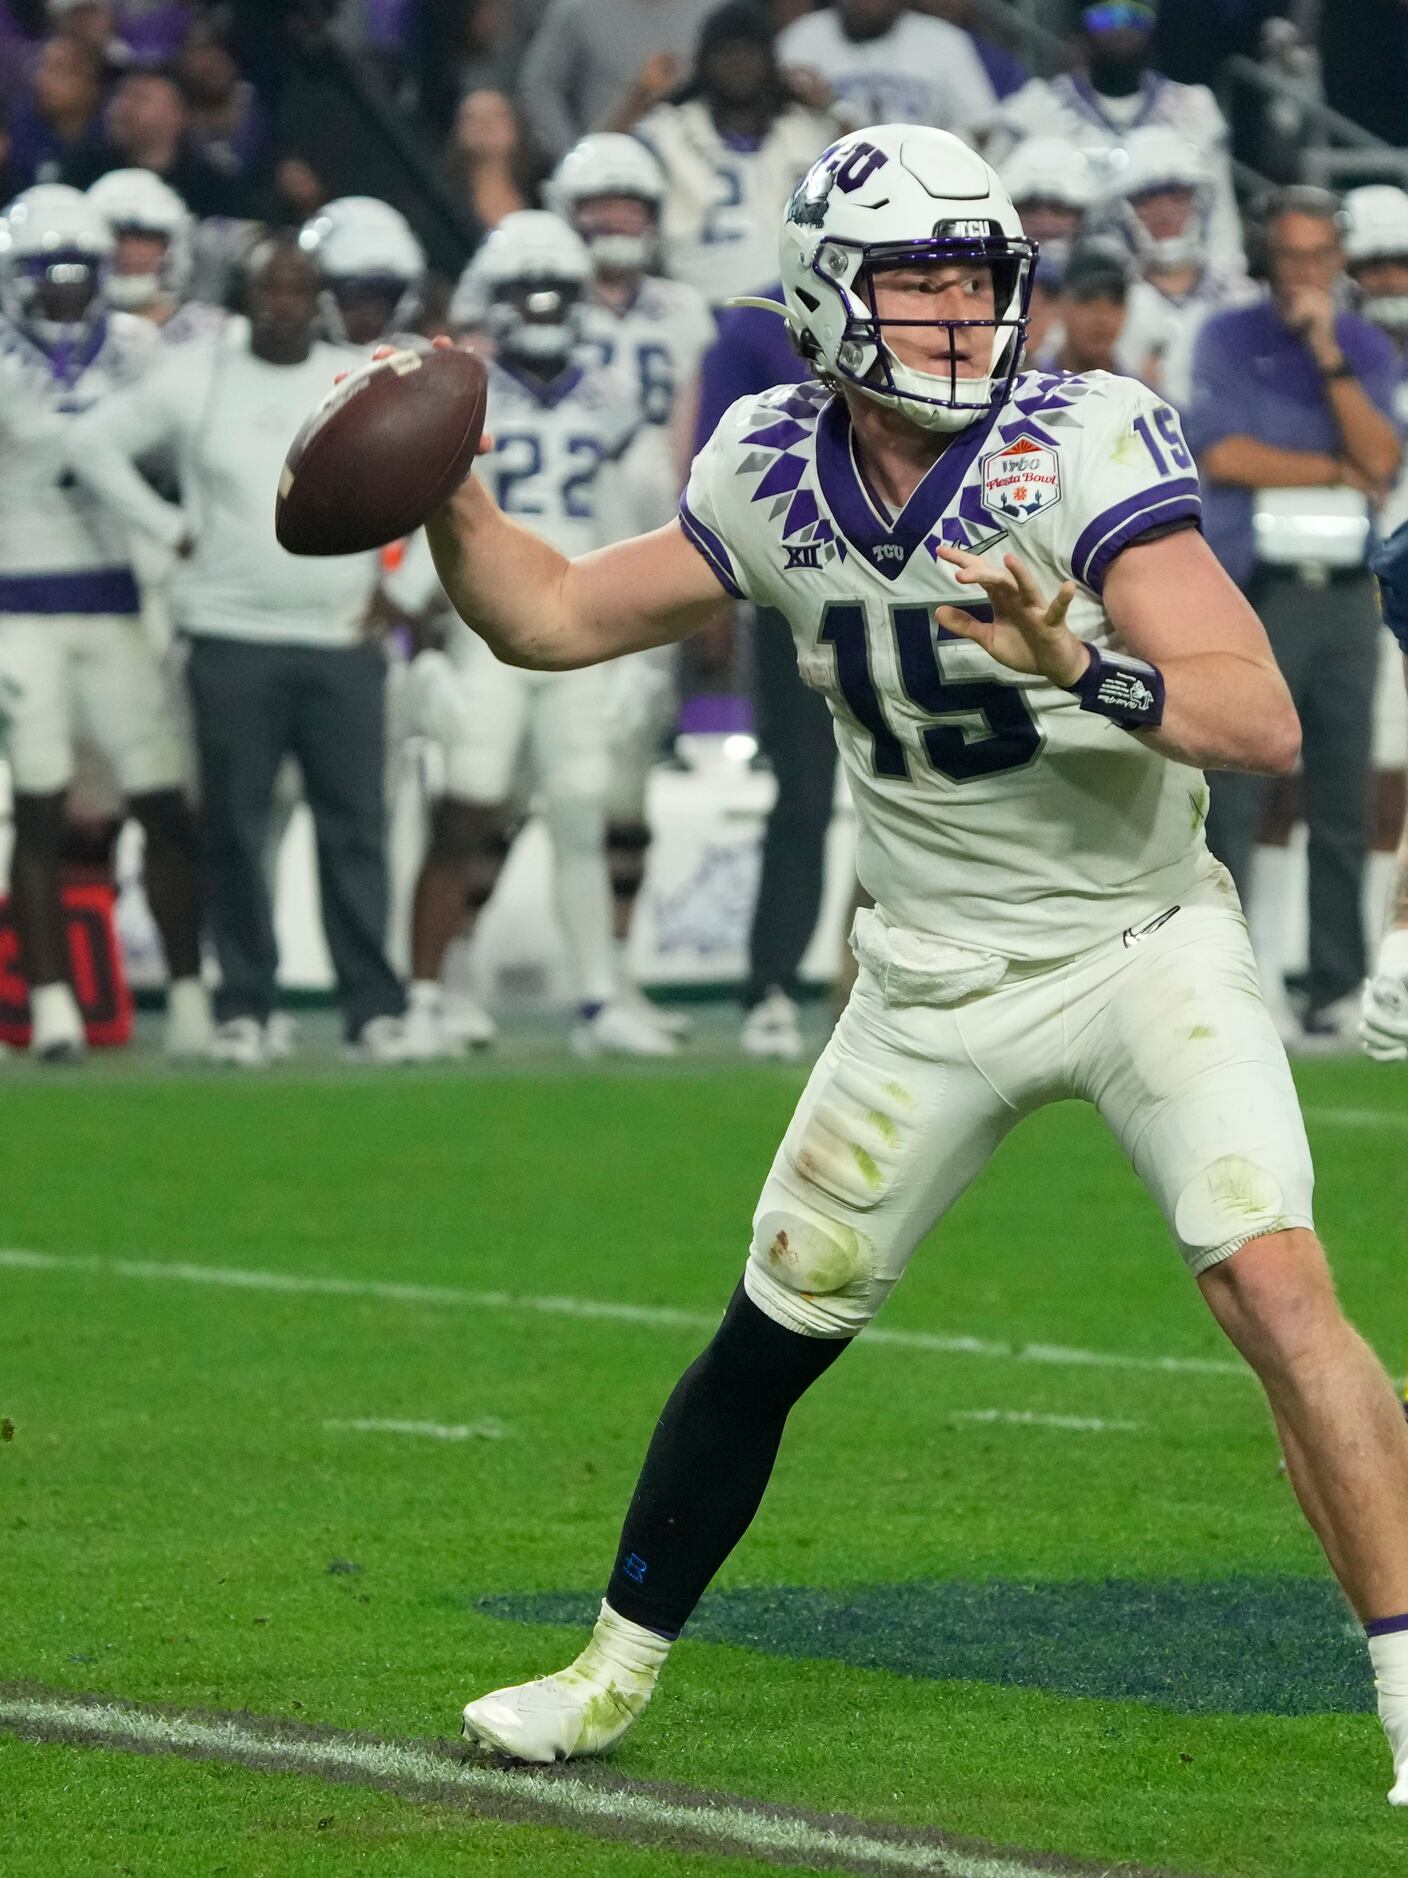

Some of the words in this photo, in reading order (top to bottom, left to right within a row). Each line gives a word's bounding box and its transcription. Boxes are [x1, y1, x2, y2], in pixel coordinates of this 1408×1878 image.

[956, 220, 991, 238] TCU
[1132, 406, 1193, 479] 15
[494, 432, 607, 519] 22
[986, 474, 1020, 491] Fiesta
[1022, 474, 1057, 485] Bowl
[781, 542, 824, 571] XII
[871, 543, 905, 562] TCU
[815, 598, 1048, 786] 15
